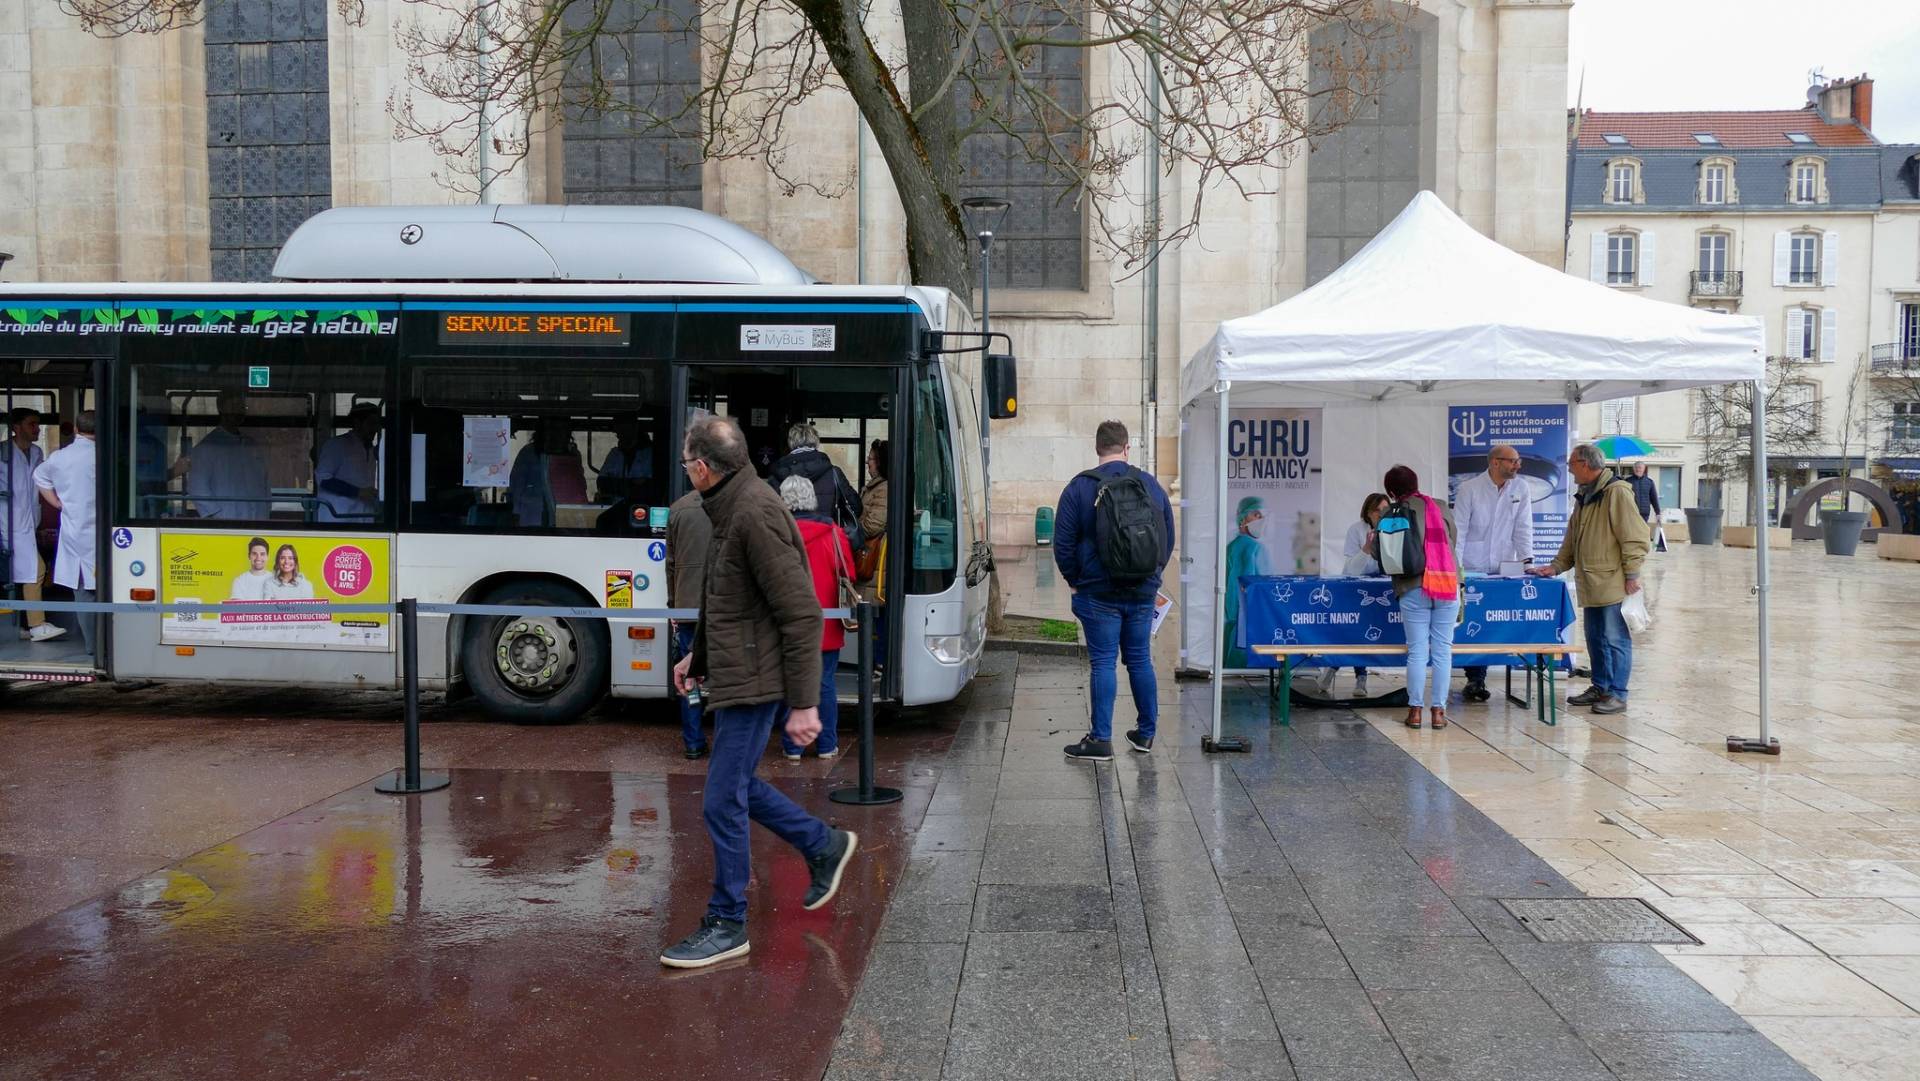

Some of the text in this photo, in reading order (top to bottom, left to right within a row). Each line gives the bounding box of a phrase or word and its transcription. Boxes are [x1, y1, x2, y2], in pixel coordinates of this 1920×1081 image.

[56, 320, 76, 333] du
[79, 320, 124, 335] grand
[128, 323, 174, 335] nancy
[178, 322, 236, 334] roulent
[240, 324, 260, 334] au
[263, 320, 306, 339] gaz
[312, 317, 399, 335] naturel
[446, 316, 622, 333] SERVICE SPECIAL
[764, 334, 805, 347] MyBus
[1502, 418, 1565, 426] CANCÉROLOGIE
[1228, 419, 1310, 457] CHRU
[1227, 458, 1310, 479] DE NANCY
[335, 555, 362, 564] PORTES
[340, 570, 356, 582] 06
[236, 613, 263, 622] MÉTIERS
[283, 613, 331, 621] CONSTRUCTION
[1291, 612, 1361, 625] CHRU DE NANCY
[1387, 612, 1403, 623] CH
[1485, 609, 1556, 622] CHRU DE NANCY
